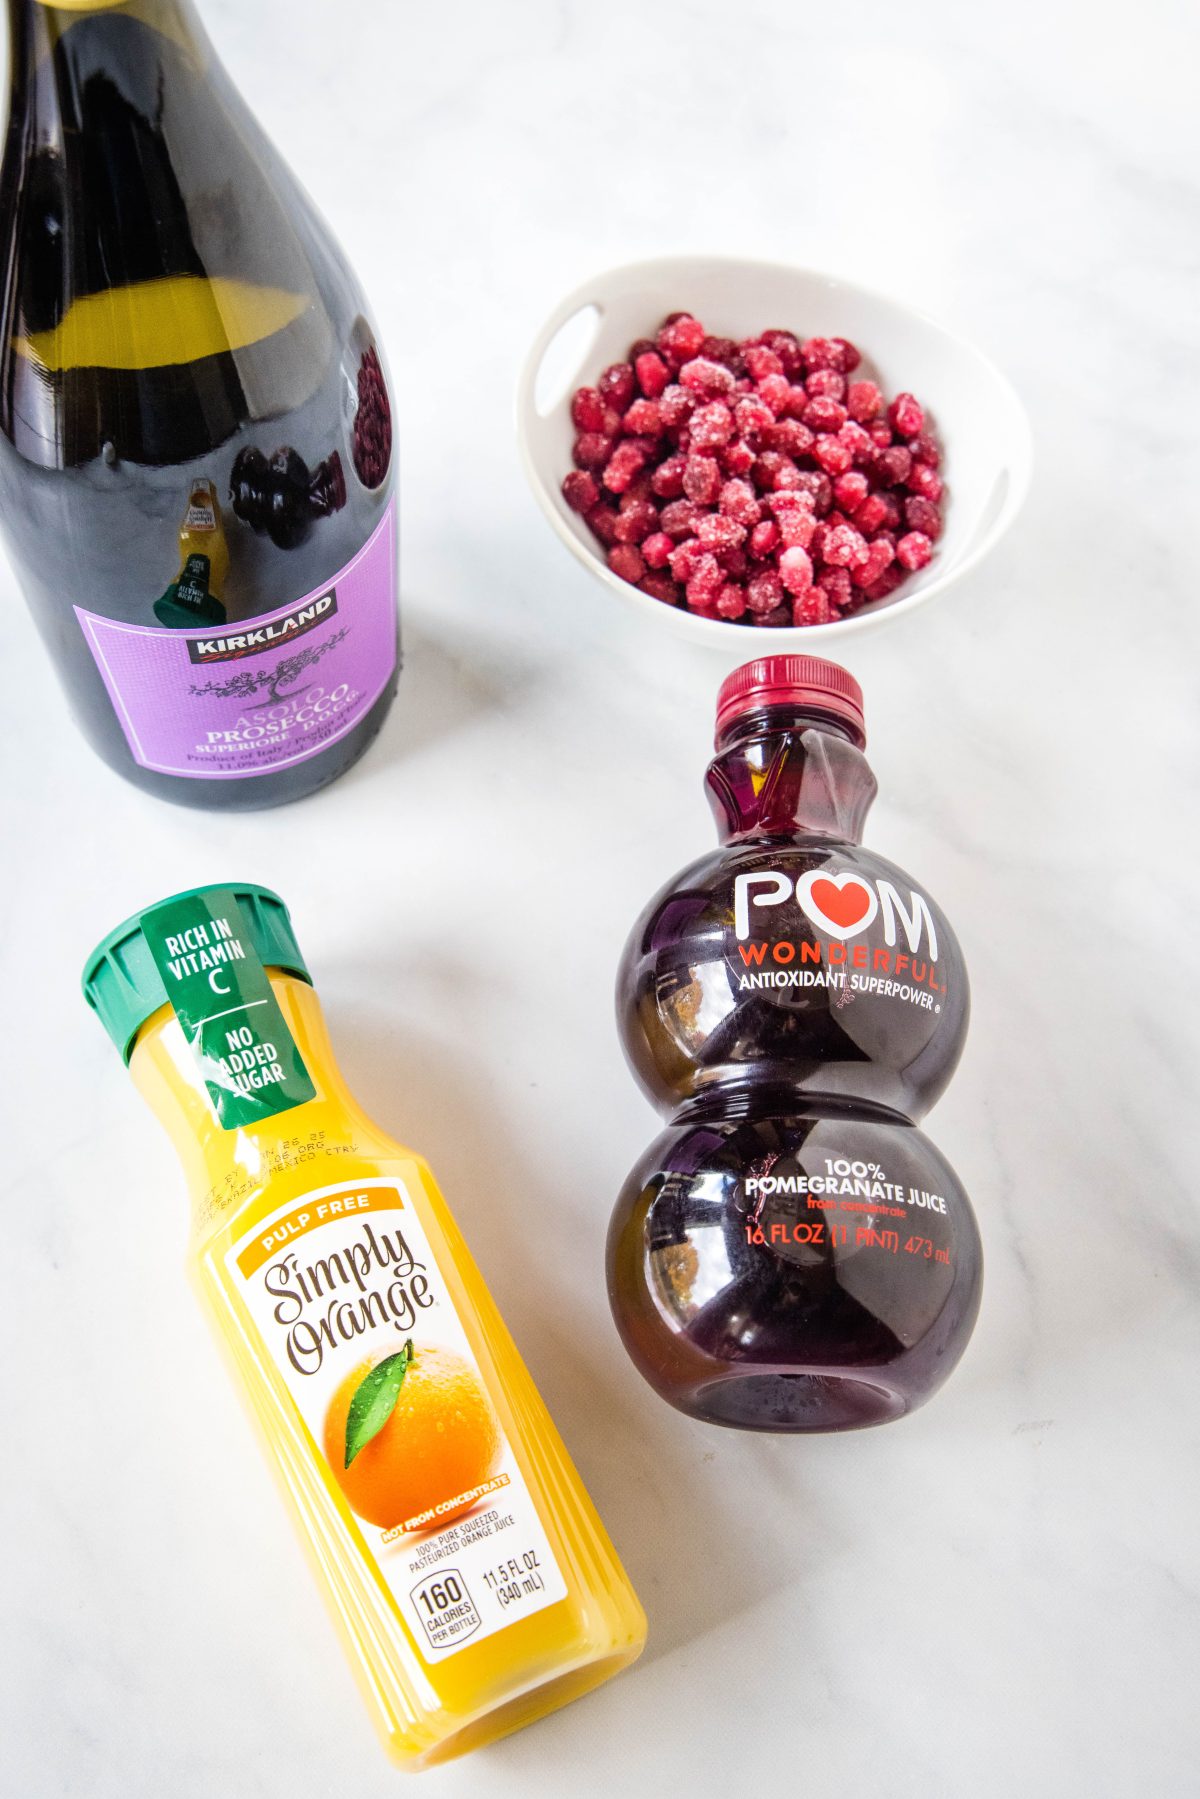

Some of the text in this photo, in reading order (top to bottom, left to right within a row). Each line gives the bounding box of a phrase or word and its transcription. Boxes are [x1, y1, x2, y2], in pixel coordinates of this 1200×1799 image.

[197, 596, 332, 654] KIRKLAND
[206, 684, 348, 743] PROSECCO
[234, 687, 325, 730] ASOLO
[195, 730, 289, 753] SUPERIORE
[735, 870, 938, 963] POM
[165, 918, 233, 957] RICH IN
[167, 939, 246, 981] VITAMIN
[208, 967, 231, 994] C
[739, 970, 934, 1011] ANTIOXIDANT SUPERPOWER
[225, 1026, 253, 1052] NO
[218, 1042, 278, 1076] ADDED
[825, 1159, 886, 1181] 100%
[745, 1176, 947, 1215] POMEGRANATE JUICE
[807, 1194, 908, 1219] from concentrate
[262, 1194, 370, 1251] PULP FREE
[745, 1225, 765, 1245] 16
[771, 1224, 793, 1244] FL
[793, 1224, 824, 1244] OZ
[832, 1224, 847, 1249] (1
[856, 1227, 900, 1255] PINT)
[904, 1236, 933, 1259] 473
[264, 1223, 427, 1325] Simply
[286, 1274, 434, 1376] Orange
[382, 1474, 510, 1543] NOT FROM CONCENTRATE
[409, 1515, 516, 1573] PASTEURIZED ORANGE JUICE
[415, 1510, 499, 1557] 100% PURE SQUEEZED
[483, 1550, 540, 1589] 11.5 FL OZ
[419, 1576, 463, 1614] 160
[496, 1572, 546, 1610] (340 mL)
[426, 1601, 472, 1632] CALORIES
[432, 1615, 478, 1643] PER BOTTLE
